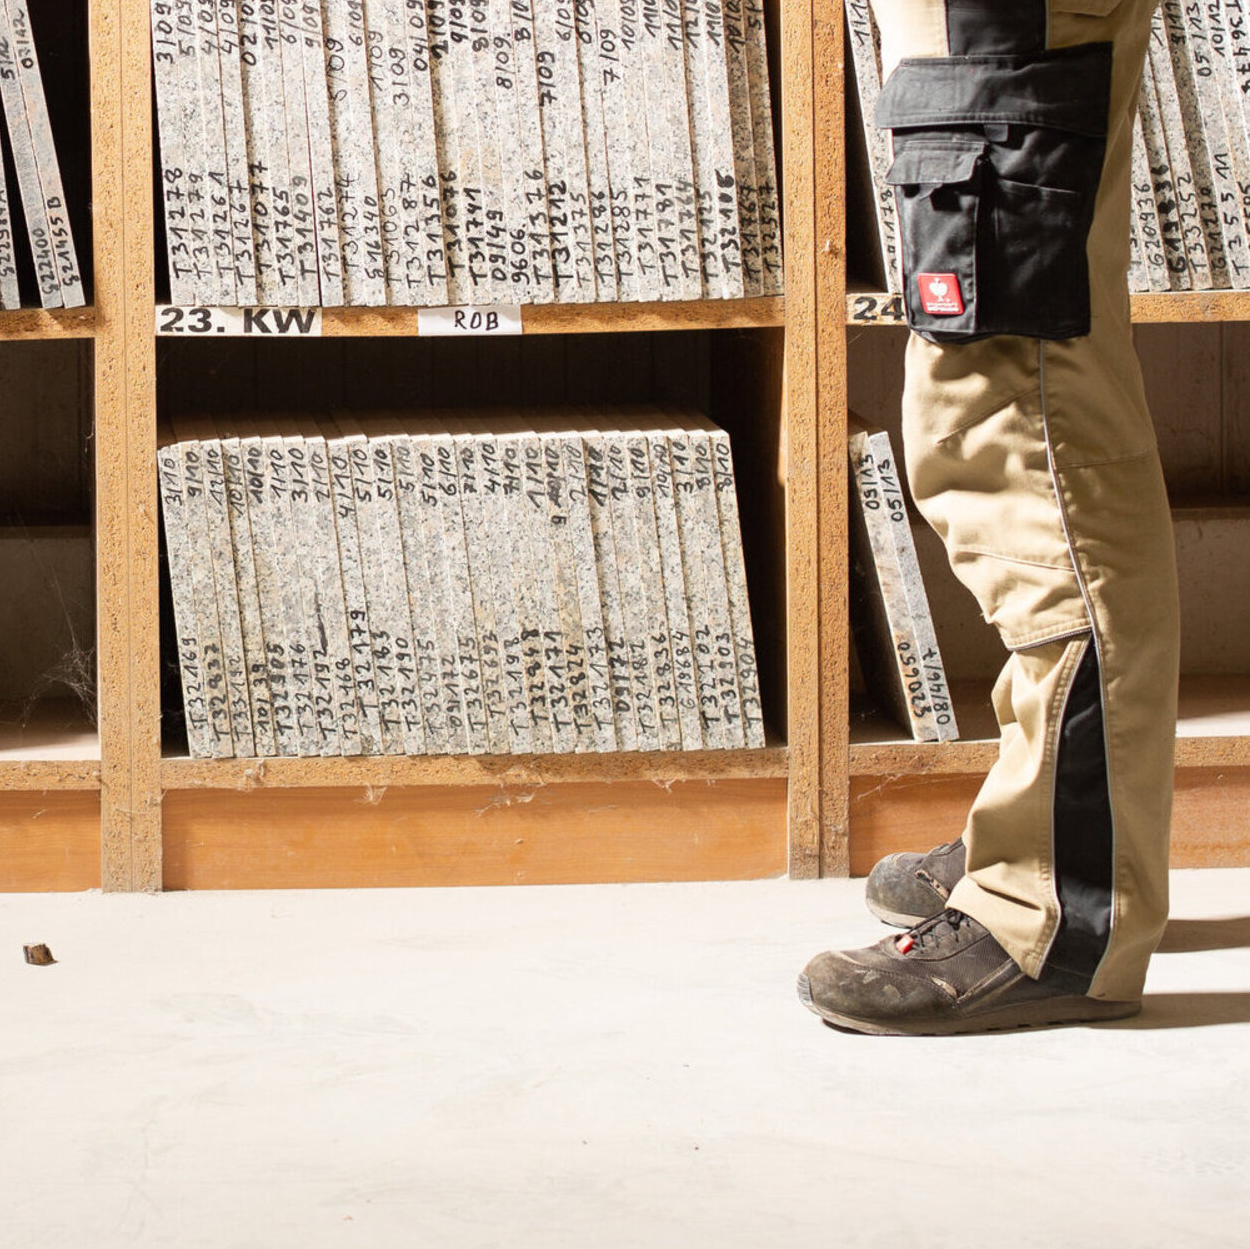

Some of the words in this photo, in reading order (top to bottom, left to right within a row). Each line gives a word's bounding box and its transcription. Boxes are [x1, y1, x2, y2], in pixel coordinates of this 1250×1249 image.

[160, 309, 225, 332] 23.
[243, 308, 316, 332] KW
[455, 310, 498, 330] ROB
